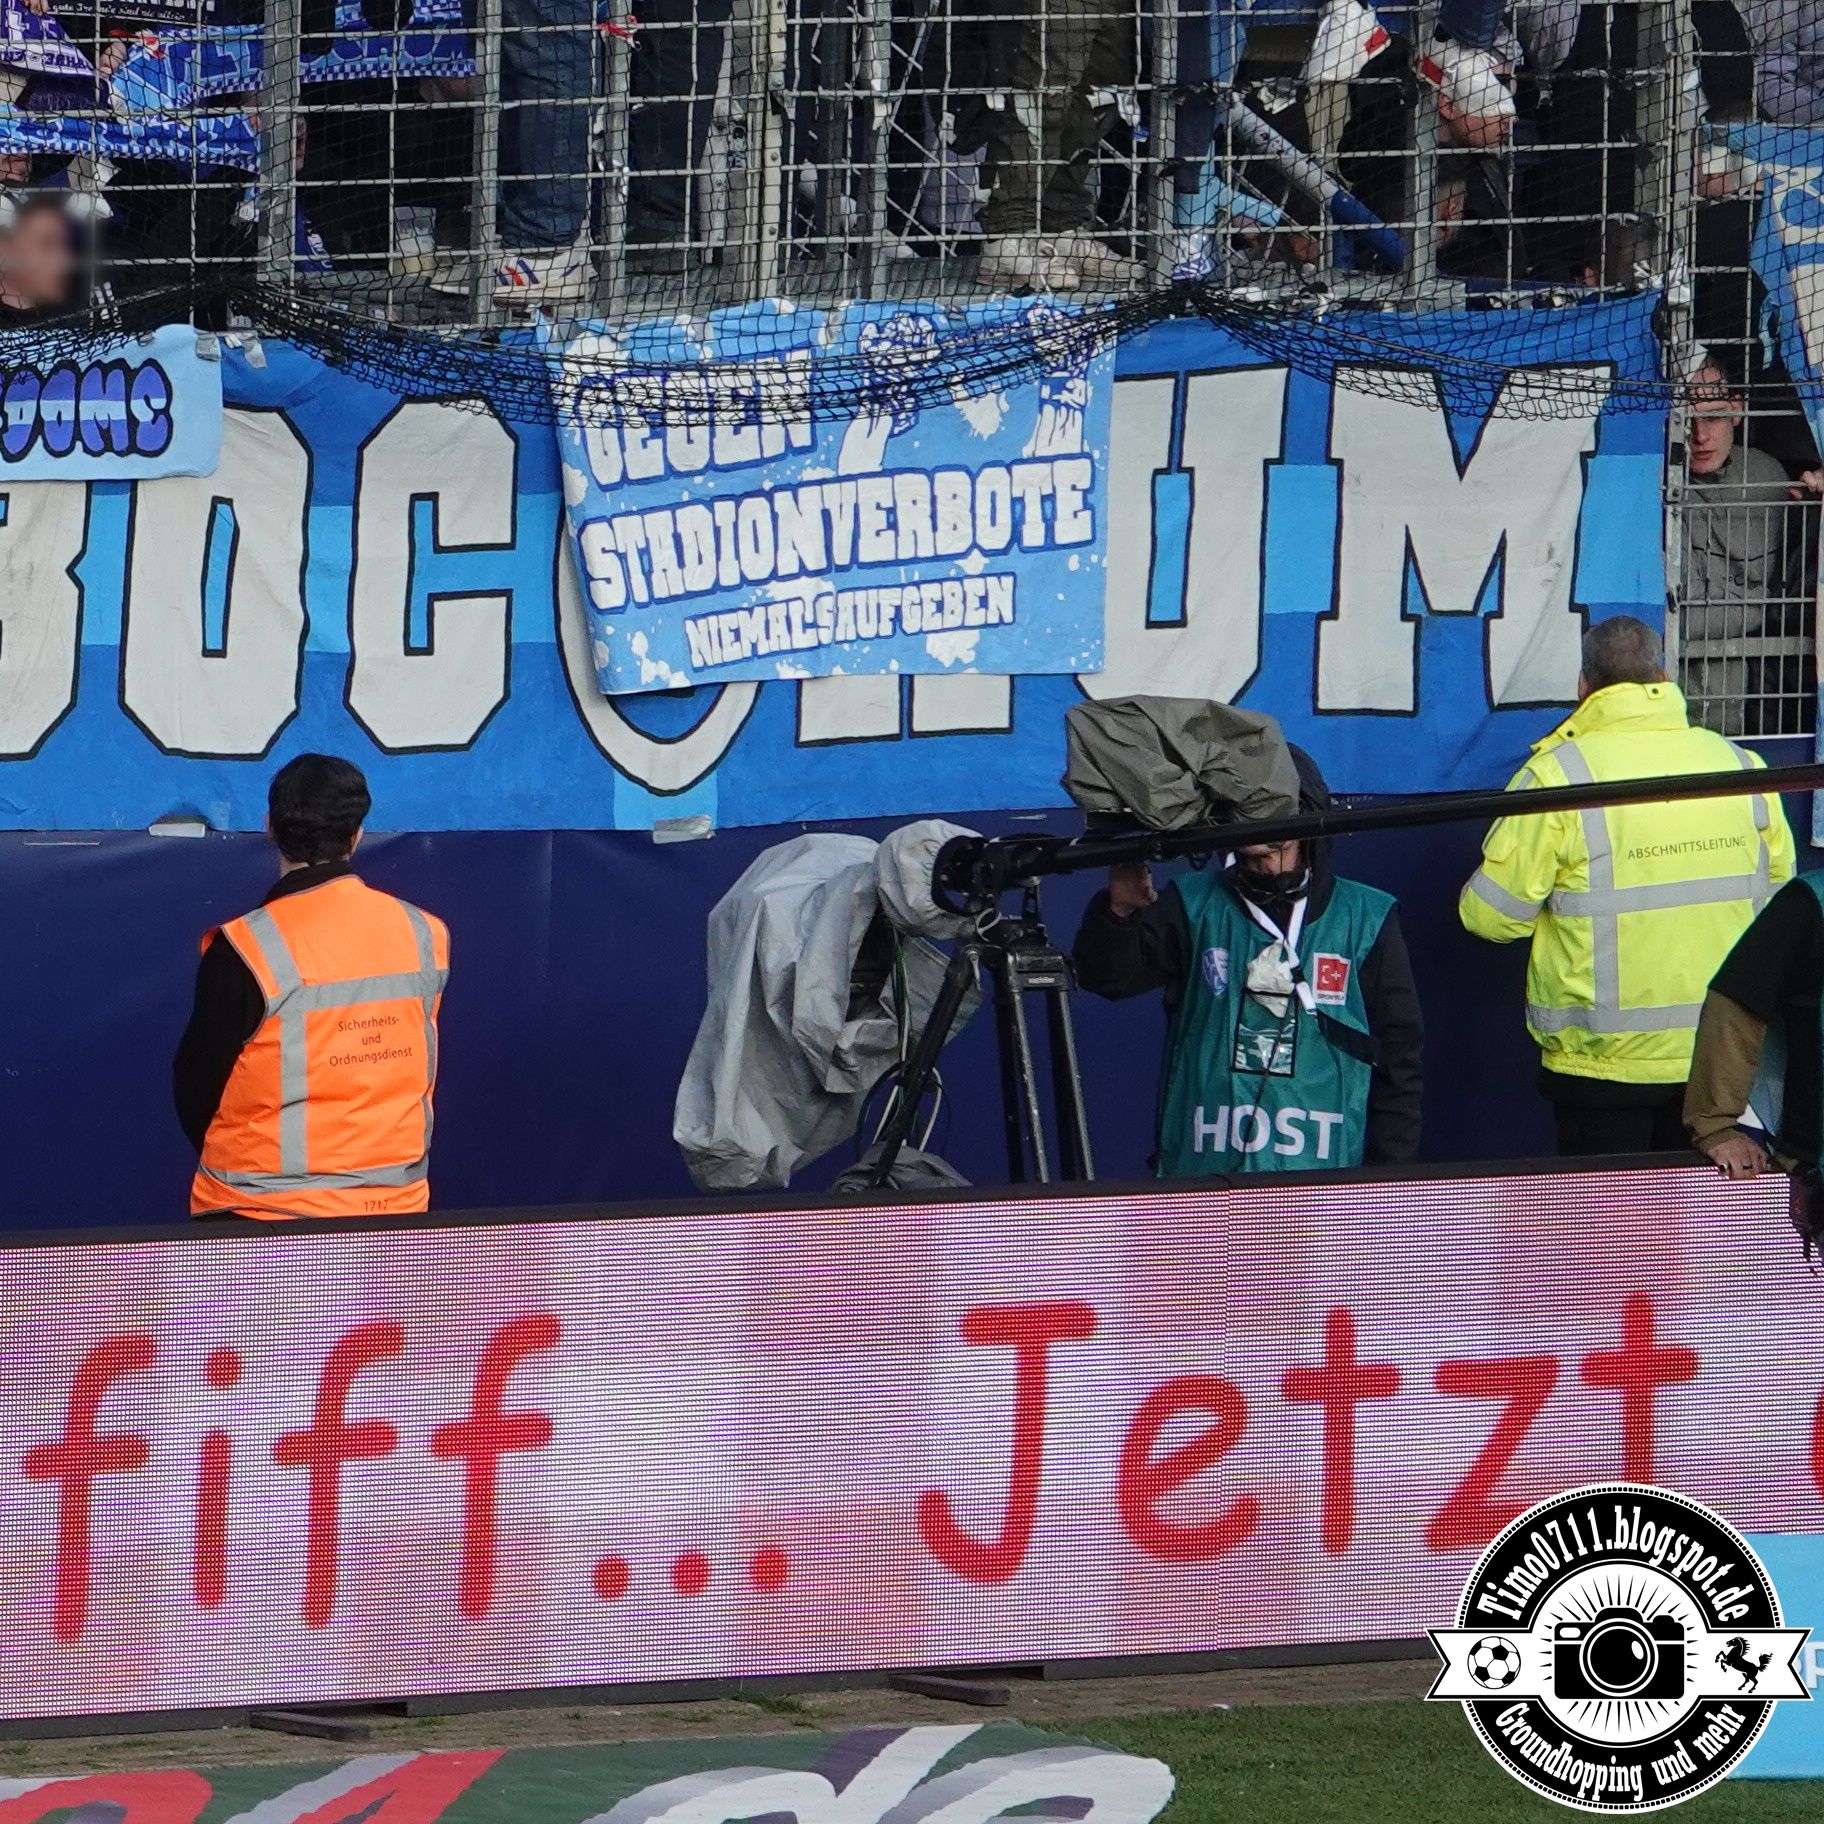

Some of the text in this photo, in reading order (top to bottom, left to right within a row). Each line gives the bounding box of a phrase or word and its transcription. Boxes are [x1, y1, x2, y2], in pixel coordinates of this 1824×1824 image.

[578, 348, 817, 486] GEGEN
[577, 456, 1096, 614] STADIONVERBOTE
[684, 575, 1017, 671] NIEMALS AUFGEBEN
[1627, 835, 1748, 862] ABSCHNITTSLEITUNG
[337, 1015, 400, 1033] Sicherheits-
[361, 1032, 382, 1046] und
[329, 1046, 413, 1067] Ordnungsdienst
[1193, 1104, 1344, 1161] HOST
[914, 1289, 1700, 1584] Jetzt
